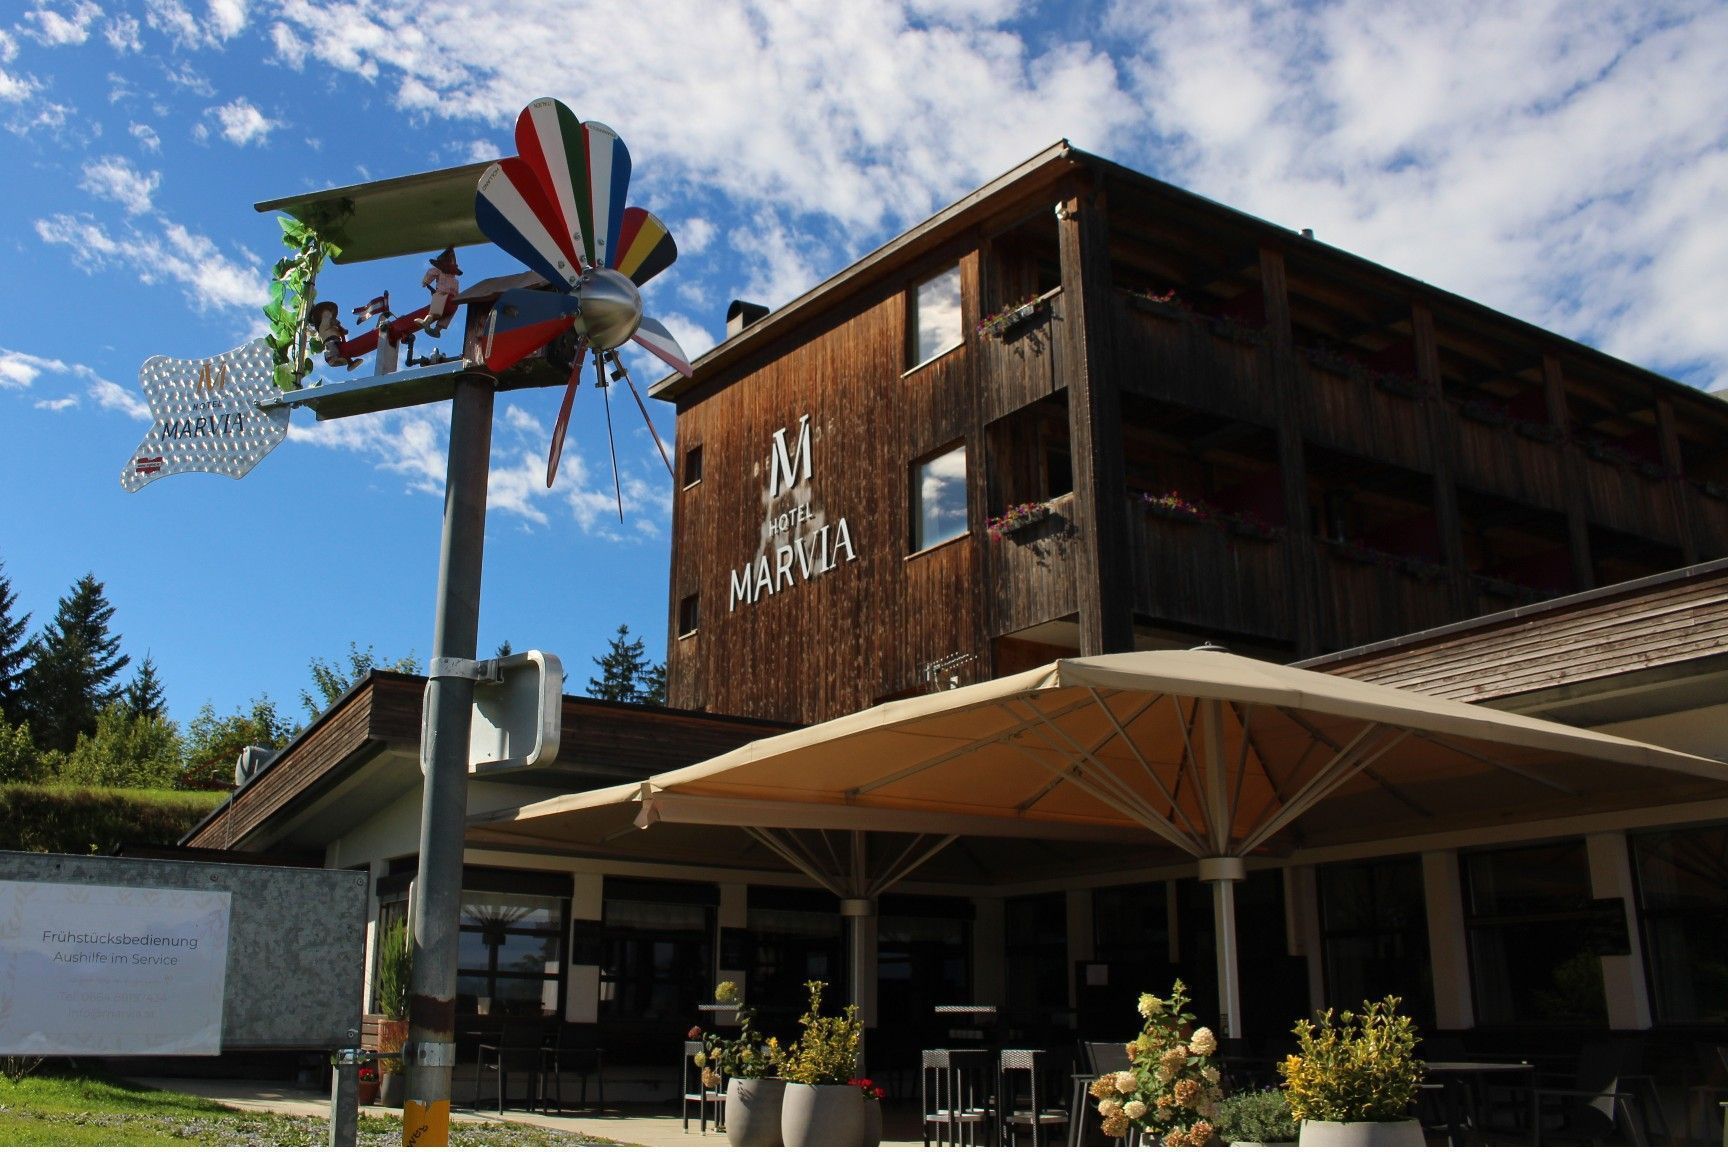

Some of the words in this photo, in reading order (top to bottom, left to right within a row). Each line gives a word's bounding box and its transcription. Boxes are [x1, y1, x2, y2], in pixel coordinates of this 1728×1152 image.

[196, 361, 227, 396] M
[193, 400, 222, 411] HOTEL
[161, 412, 244, 441] MARVIA
[769, 413, 812, 499] M
[768, 502, 813, 537] HOTEL
[729, 517, 857, 612] MARVIA
[42, 930, 198, 950] Frühstücksbedienung
[53, 951, 108, 964] Aushilfe
[111, 952, 128, 965] im
[131, 953, 178, 966] Service
